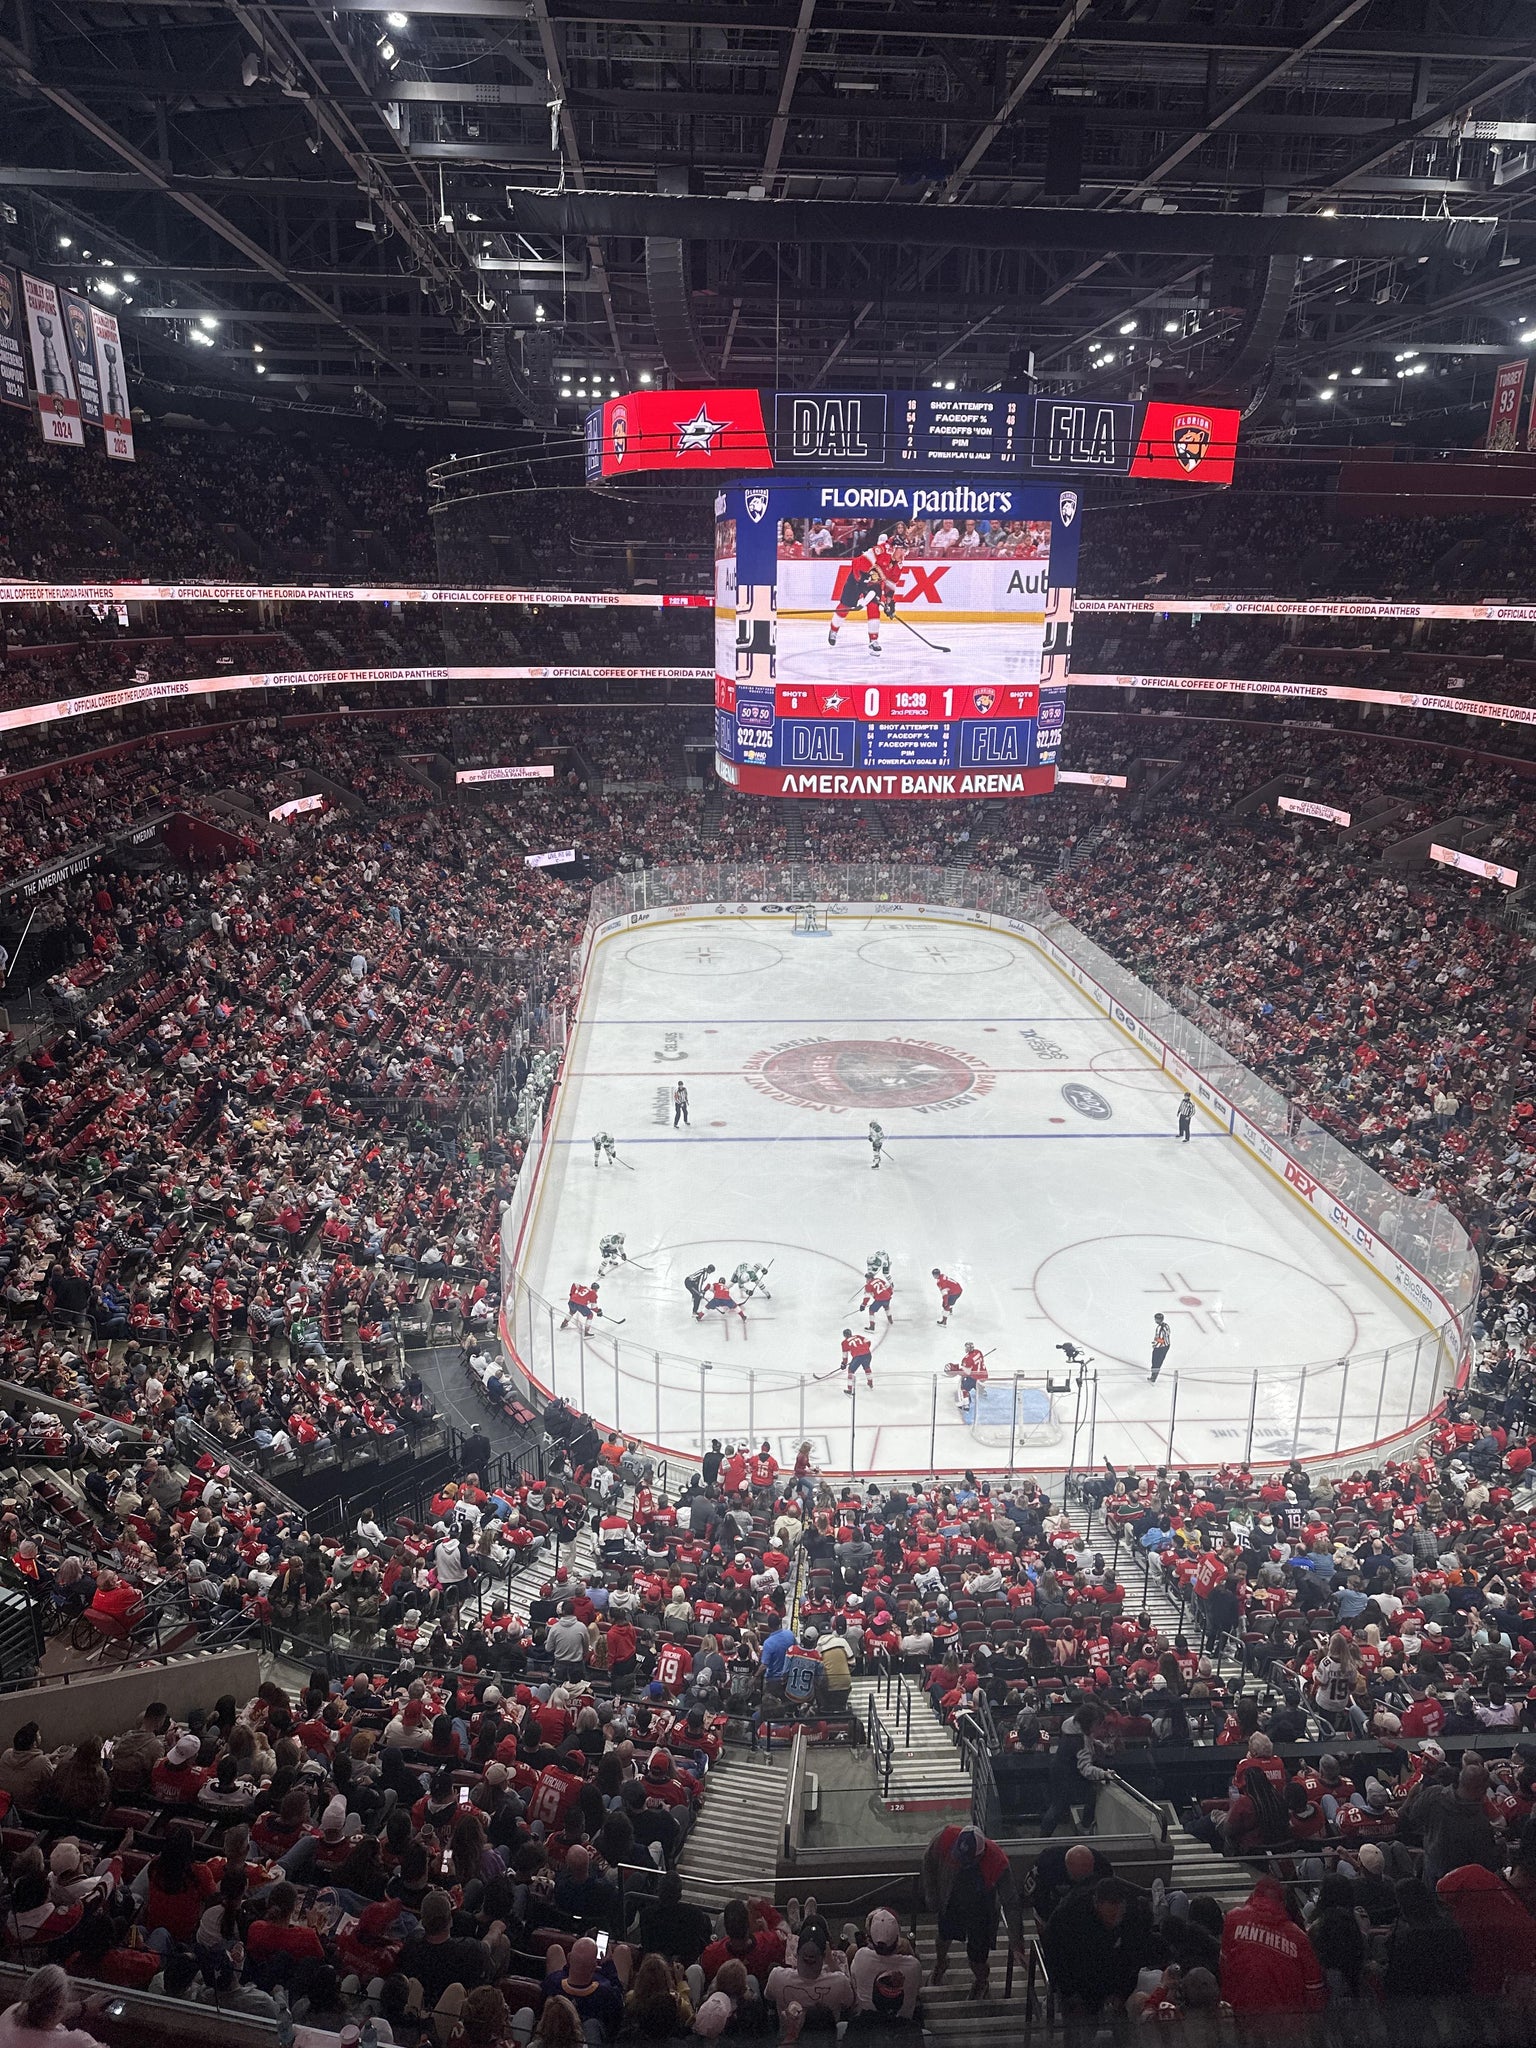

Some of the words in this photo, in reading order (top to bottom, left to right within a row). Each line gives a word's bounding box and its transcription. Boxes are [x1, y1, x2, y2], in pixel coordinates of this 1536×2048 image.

[930, 402, 952, 410] SHOT
[953, 402, 994, 411] ATTEMPTS
[1500, 389, 1515, 413] 93
[793, 399, 869, 458] DAL
[935, 414, 979, 422] FACEOFF
[980, 415, 987, 423] %
[1177, 416, 1209, 428] FLORIDA
[909, 425, 914, 433] 7
[930, 426, 972, 435] FACEOFFS
[1049, 406, 1115, 463] FLA
[908, 437, 913, 447] 2
[1007, 440, 1012, 449] 2
[821, 488, 908, 507] FLORIDA
[912, 486, 1013, 521] panthers
[44, 589, 55, 599] THE
[56, 589, 78, 599] FLORIDA
[78, 588, 114, 598] PANTHERS
[178, 588, 212, 598] OFFICIAL
[214, 588, 244, 598] COFFEE
[246, 589, 256, 598] OF
[258, 589, 273, 598] THE
[274, 589, 307, 598] FLORIDA
[308, 590, 354, 599] PANTHERS
[432, 592, 471, 600] OFFICIAL
[472, 593, 505, 602] COFFEE
[506, 594, 517, 602] OF
[518, 594, 535, 602] THE
[536, 595, 573, 603] FLORIDA
[574, 595, 620, 604] PANTHERS
[1107, 603, 1154, 611] PANTHERS
[1236, 604, 1275, 612] OFFICIAL
[1276, 605, 1307, 613] COFFEE
[1308, 605, 1320, 613] OF
[1321, 605, 1338, 614] THE
[1340, 606, 1377, 615] FLORIDA
[1378, 607, 1421, 616] PANTHERS
[1497, 609, 1527, 619] OFFICIAL
[273, 672, 306, 683] OFFICIAL
[308, 671, 336, 681] COFFEE
[337, 670, 348, 679] OF
[351, 670, 367, 679] THE
[368, 669, 403, 678] FLORIDA
[405, 668, 448, 677] PANTHERS
[553, 669, 592, 677] OFFICIAL
[593, 669, 625, 677] COFFEE
[626, 669, 638, 677] OF
[641, 669, 656, 677] THE
[658, 669, 693, 677] FLORIDA
[1141, 678, 1179, 687] OFFICIAL
[1181, 680, 1214, 689] COFFEE
[1216, 681, 1228, 690] OF
[1230, 682, 1245, 691] THE
[1247, 683, 1280, 693] FLORIDA
[1282, 685, 1328, 696] PANTHERS
[74, 701, 98, 713] OFFICIAL
[133, 689, 153, 702] FLORIDA
[153, 683, 189, 697] PANTHERS
[864, 687, 880, 717] 0
[942, 688, 953, 717] 1
[742, 707, 751, 717] 50
[760, 709, 769, 719] 50
[1422, 697, 1454, 709] OFFICIAL
[1455, 701, 1478, 714] COFFEE
[1480, 705, 1488, 715] OF
[1488, 706, 1501, 717] THE
[1502, 708, 1531, 722] FLORIDA
[737, 728, 773, 748] $22,225
[792, 726, 844, 760] DAL
[972, 726, 1018, 761] FLA
[782, 774, 897, 793] AMERANT
[901, 774, 955, 793] BANK
[960, 773, 1025, 793] ARENA
[133, 825, 156, 844] AMERANT
[24, 884, 37, 896] THE
[37, 867, 69, 891] AMERANT
[69, 857, 91, 876] VAULT
[885, 1036, 990, 1068] AMERANT
[911, 1093, 979, 1114] ARENA
[1284, 1161, 1317, 1203] DEX
[1334, 1206, 1348, 1228] CH
[1357, 1228, 1372, 1250] CH
[1403, 1271, 1433, 1309] BioStem
[1288, 1514, 1301, 1528] 19
[659, 1659, 679, 1684] 19
[792, 1668, 814, 1691] 19
[1329, 1680, 1348, 1700] 19
[542, 1774, 569, 1794] TKACHUK
[534, 1785, 560, 1824] 19
[1234, 1925, 1298, 1958] PANTHERS
